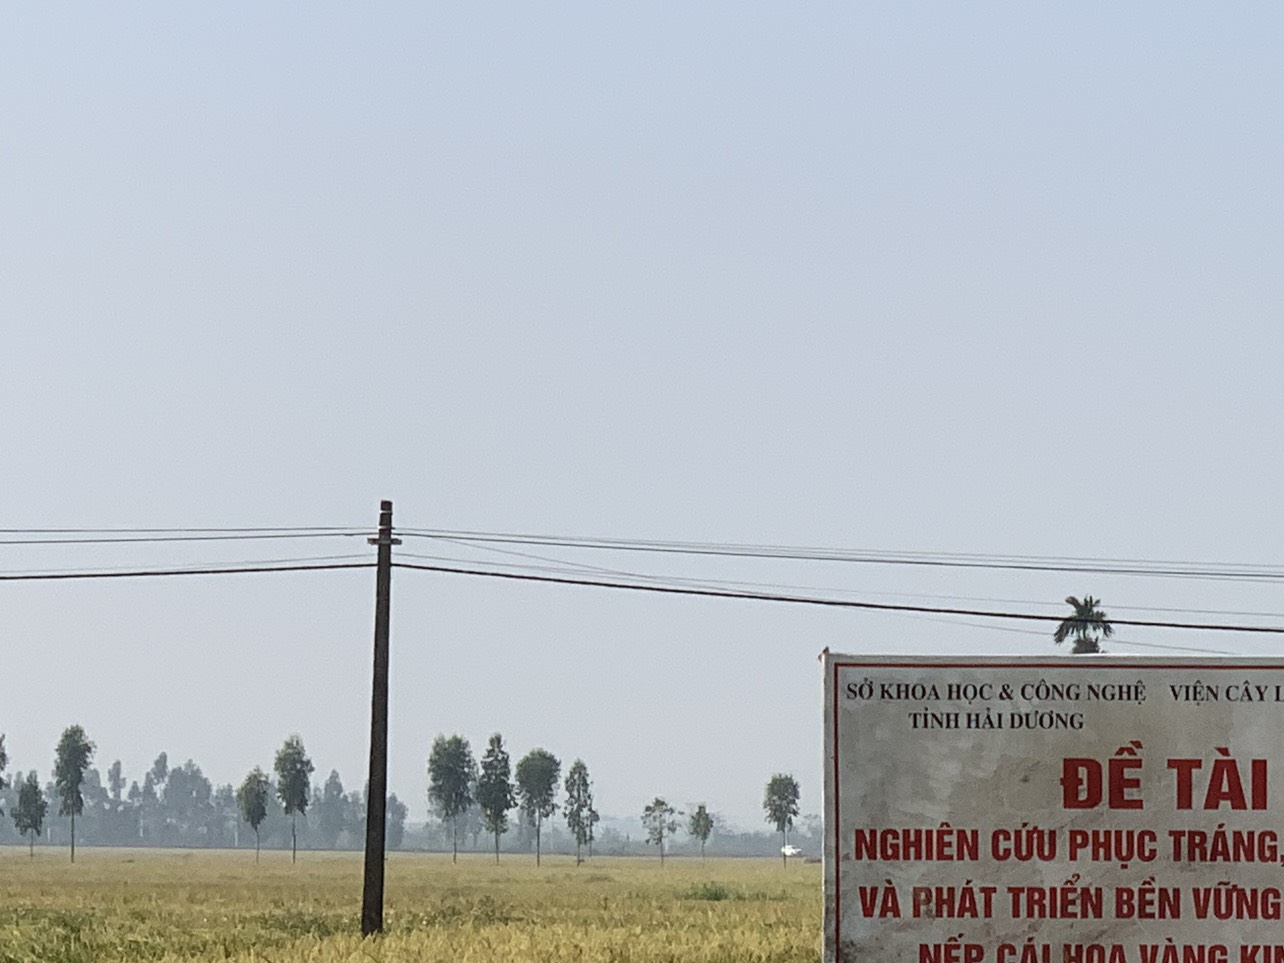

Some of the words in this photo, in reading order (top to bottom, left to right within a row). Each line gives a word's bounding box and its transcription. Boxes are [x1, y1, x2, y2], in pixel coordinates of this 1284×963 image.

[846, 678, 873, 700] SỞ
[880, 683, 939, 700] KHOA
[948, 683, 993, 704] HỌC
[999, 684, 1014, 700] &
[1021, 680, 1080, 701] CÔNG
[1087, 680, 1146, 705] NGHỆ
[1170, 680, 1219, 706] VIỆN
[1226, 680, 1268, 702] CÂY
[909, 707, 960, 729] TỈNH
[967, 707, 1003, 729] HẢI
[1010, 710, 1083, 730] DƯƠNG
[1060, 740, 1144, 809] ĐỀ
[1167, 747, 1267, 810] TÀI
[855, 822, 978, 861] NGHIÊN
[991, 822, 1056, 861] CỨU
[1069, 830, 1156, 869] PHỤC
[859, 879, 900, 918] VÀ
[913, 879, 996, 918] PHÁT
[1007, 873, 1103, 919] TRIỂN
[1116, 876, 1180, 919] BỀN
[1192, 881, 1281, 919] VỮNG
